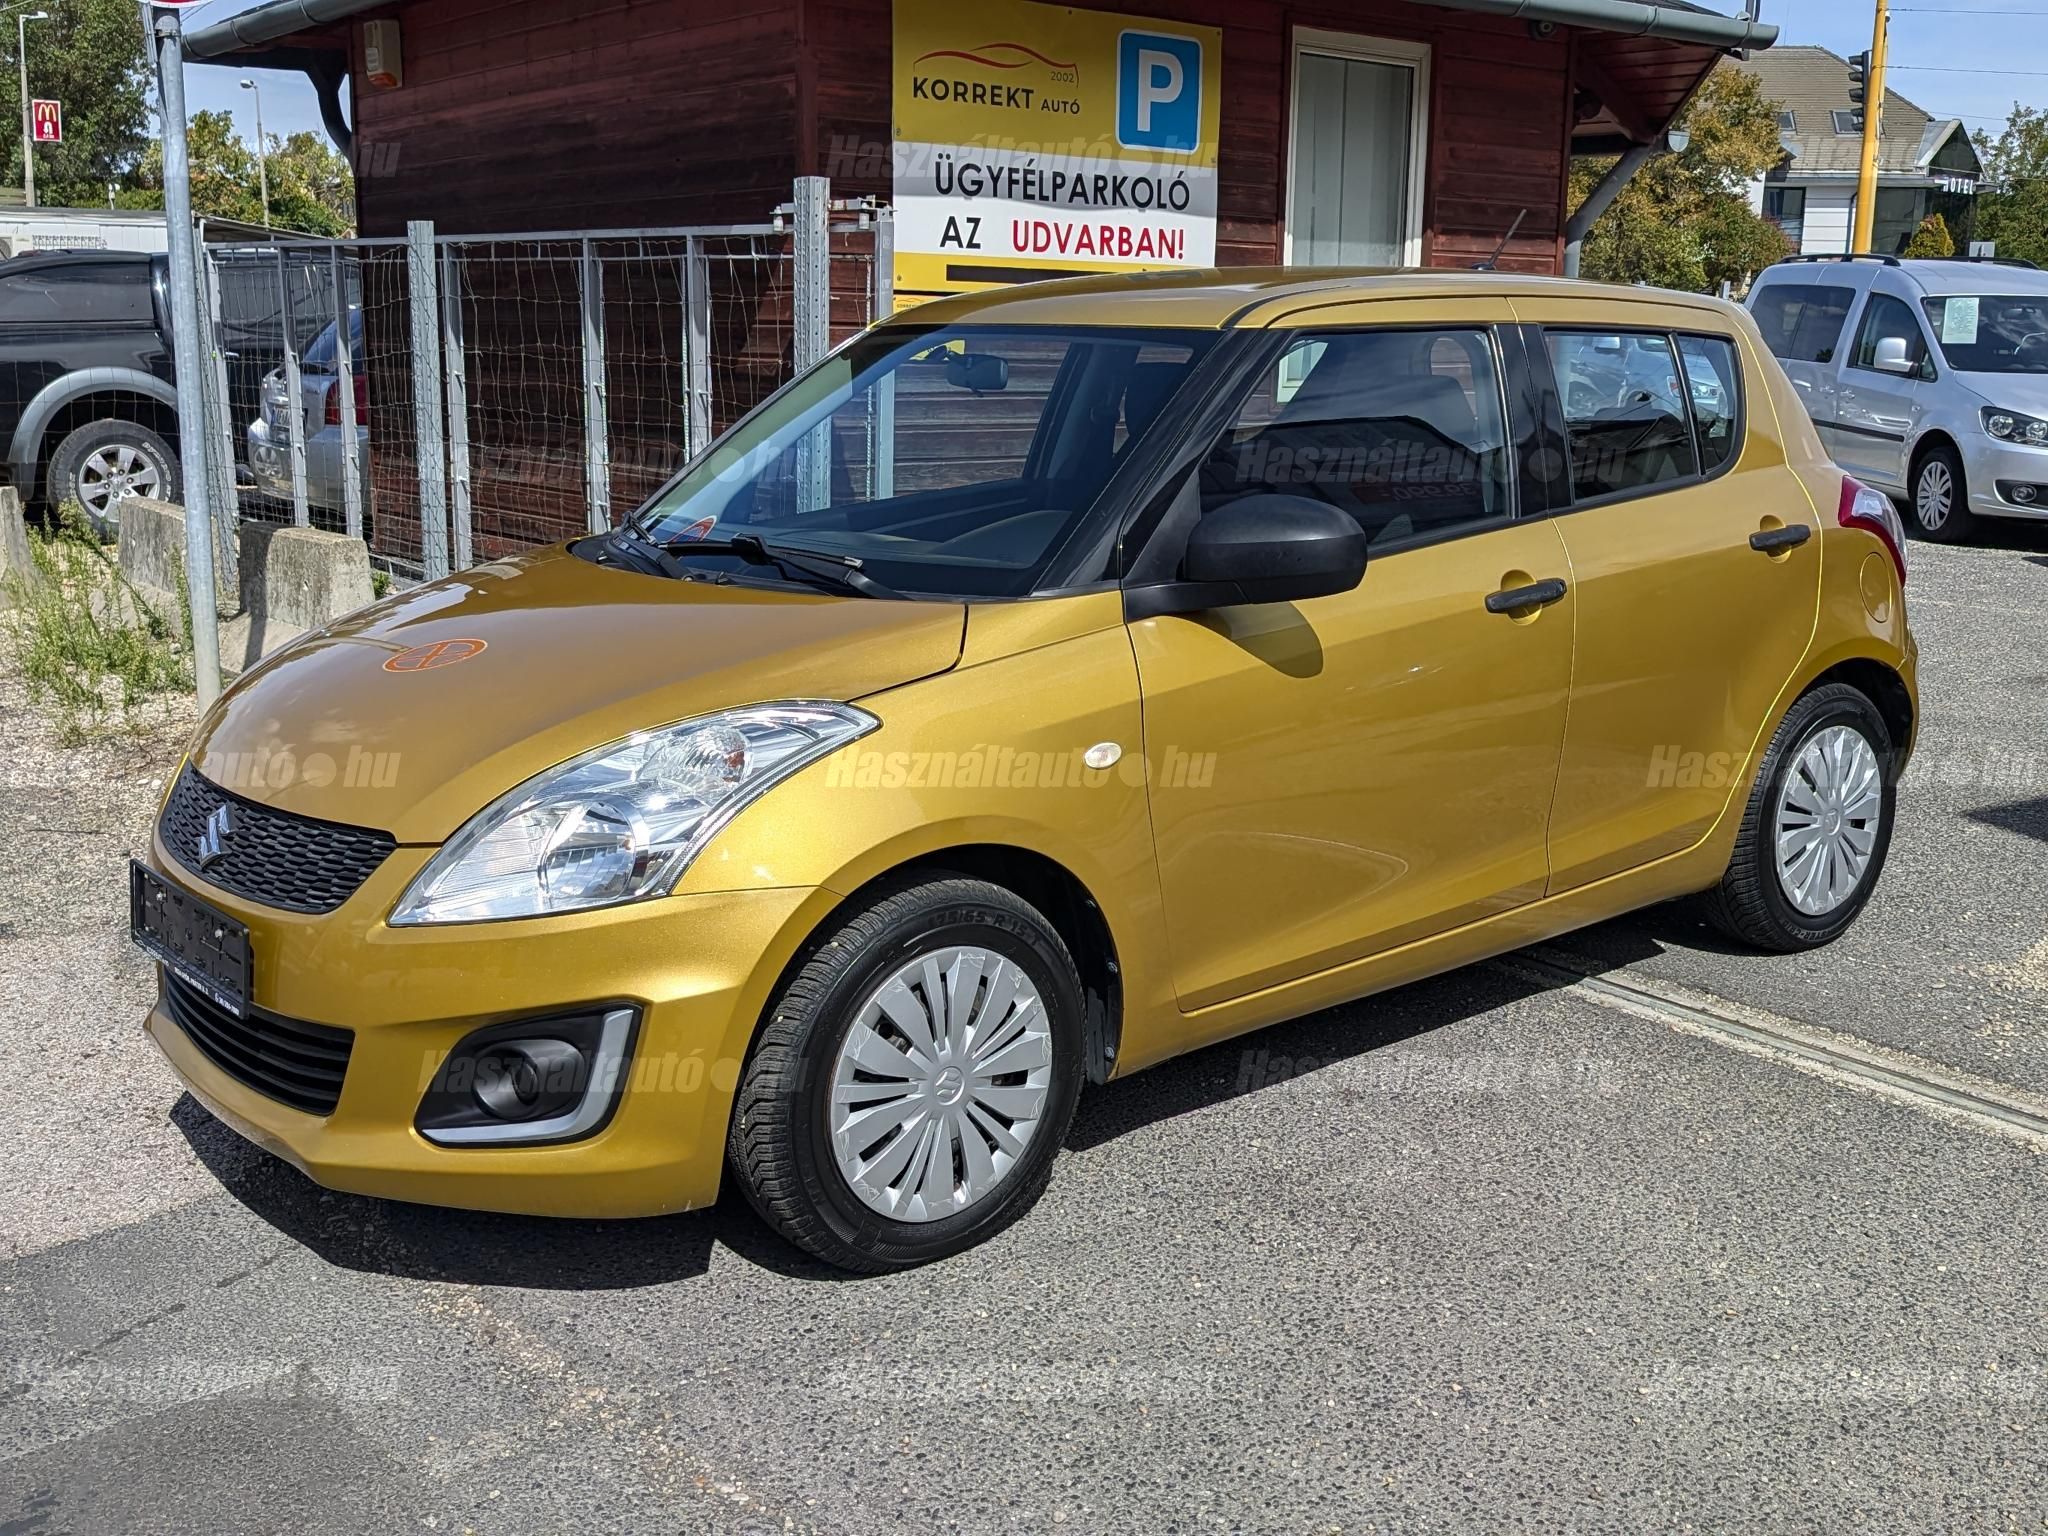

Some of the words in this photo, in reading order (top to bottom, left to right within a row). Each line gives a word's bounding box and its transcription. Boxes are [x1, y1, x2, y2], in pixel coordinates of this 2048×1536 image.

[912, 76, 1035, 110] KORREKT
[1041, 97, 1081, 115] AUTÓ
[1050, 70, 1075, 84] 2002
[1137, 48, 1184, 132] P
[934, 152, 1191, 211] ÜGYFÉLPARKOLÓ
[939, 215, 982, 250] AZ
[1012, 219, 1185, 260] UDVARBAN!
